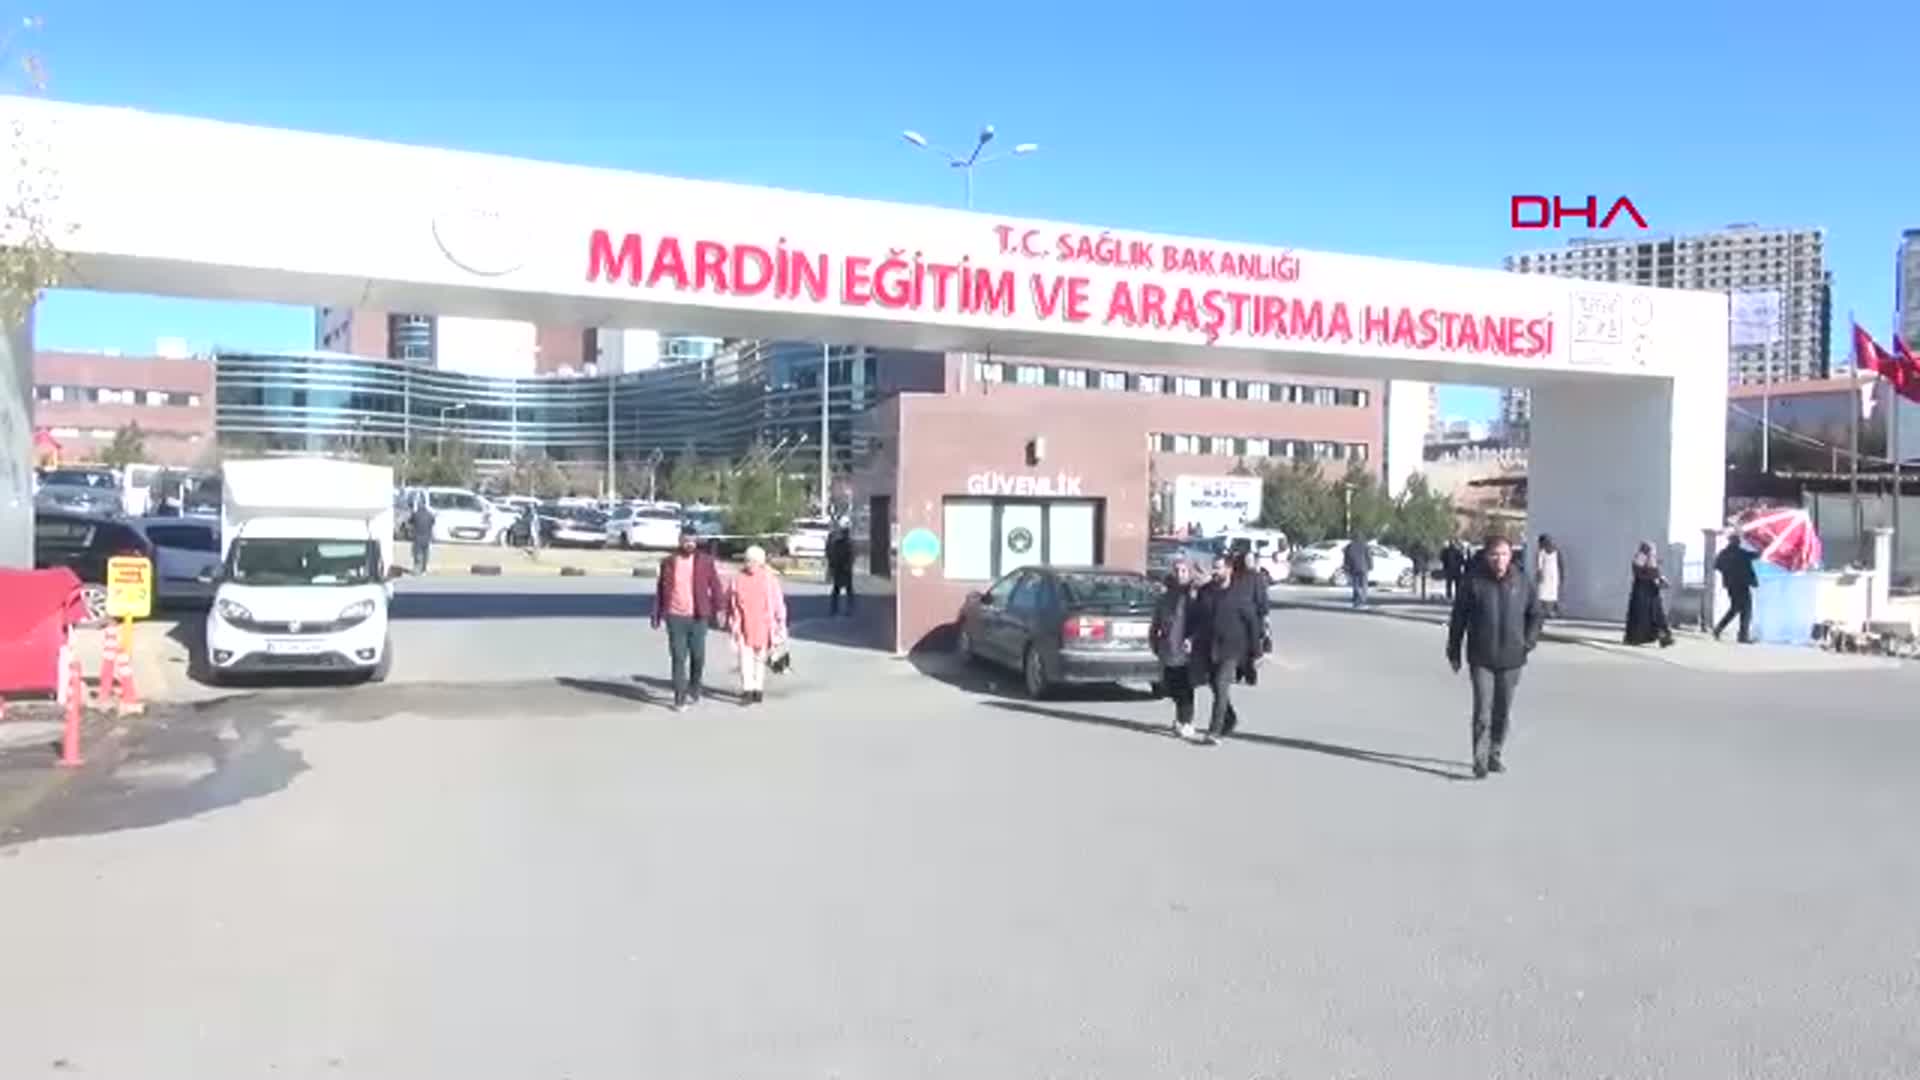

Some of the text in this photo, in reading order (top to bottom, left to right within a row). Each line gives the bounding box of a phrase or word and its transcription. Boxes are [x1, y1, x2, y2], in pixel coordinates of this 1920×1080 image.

[994, 225, 1300, 280] T.C. SAĞLIK BAKANLIĞI
[586, 229, 828, 300] MARDİN
[841, 248, 1015, 315] EĞİTİM
[1029, 272, 1092, 324] VE
[1102, 279, 1353, 346] ARAŞTIRMA
[1358, 303, 1555, 358] HASTANESİ
[967, 472, 1081, 496] GÜVENLİK
